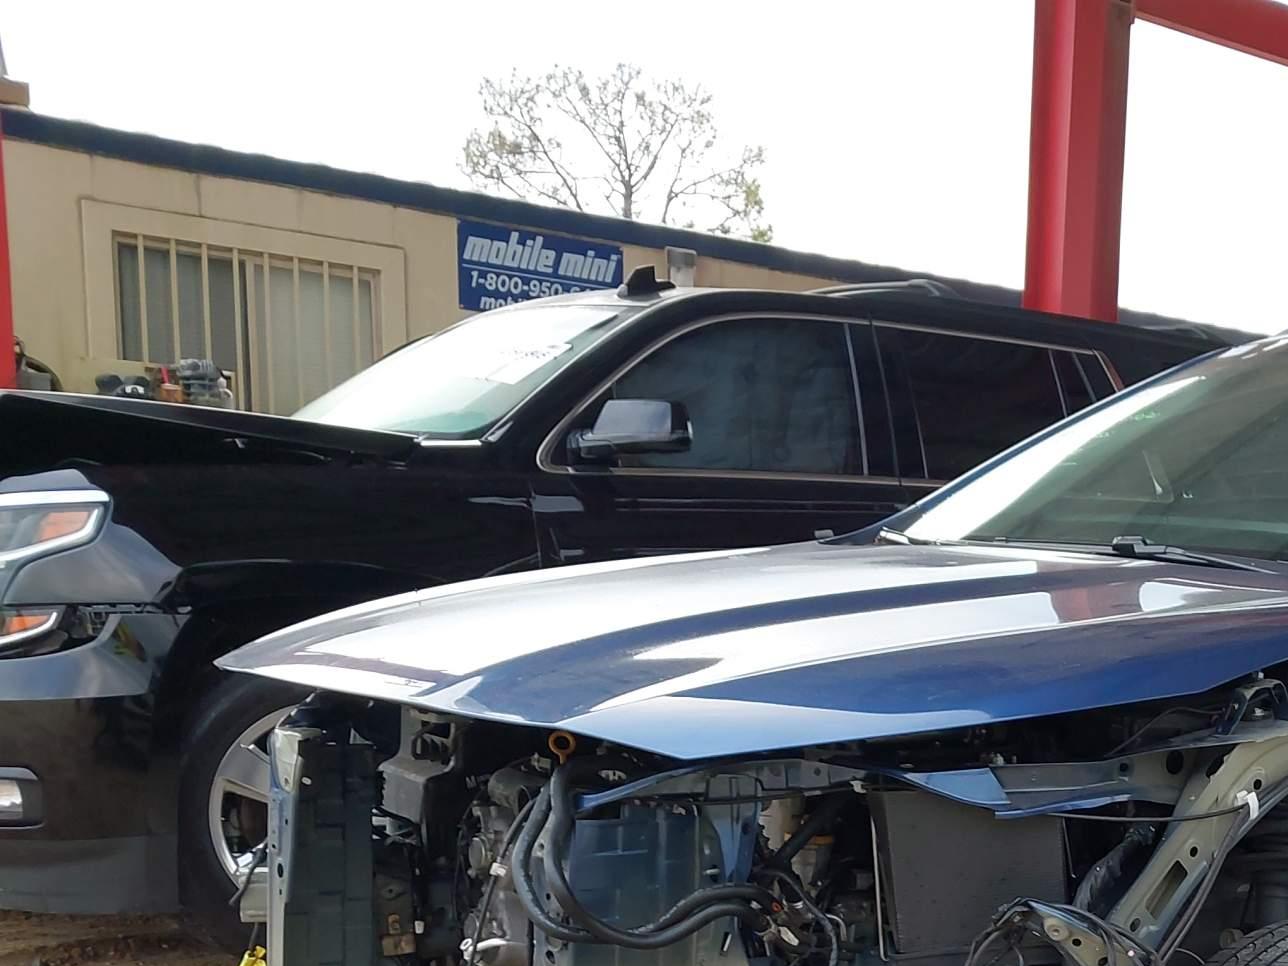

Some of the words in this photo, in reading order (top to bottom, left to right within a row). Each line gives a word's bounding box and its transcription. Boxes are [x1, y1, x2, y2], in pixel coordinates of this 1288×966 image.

[463, 231, 556, 273] mobile
[558, 250, 617, 283] mini
[470, 270, 592, 298] 1-800-950-
